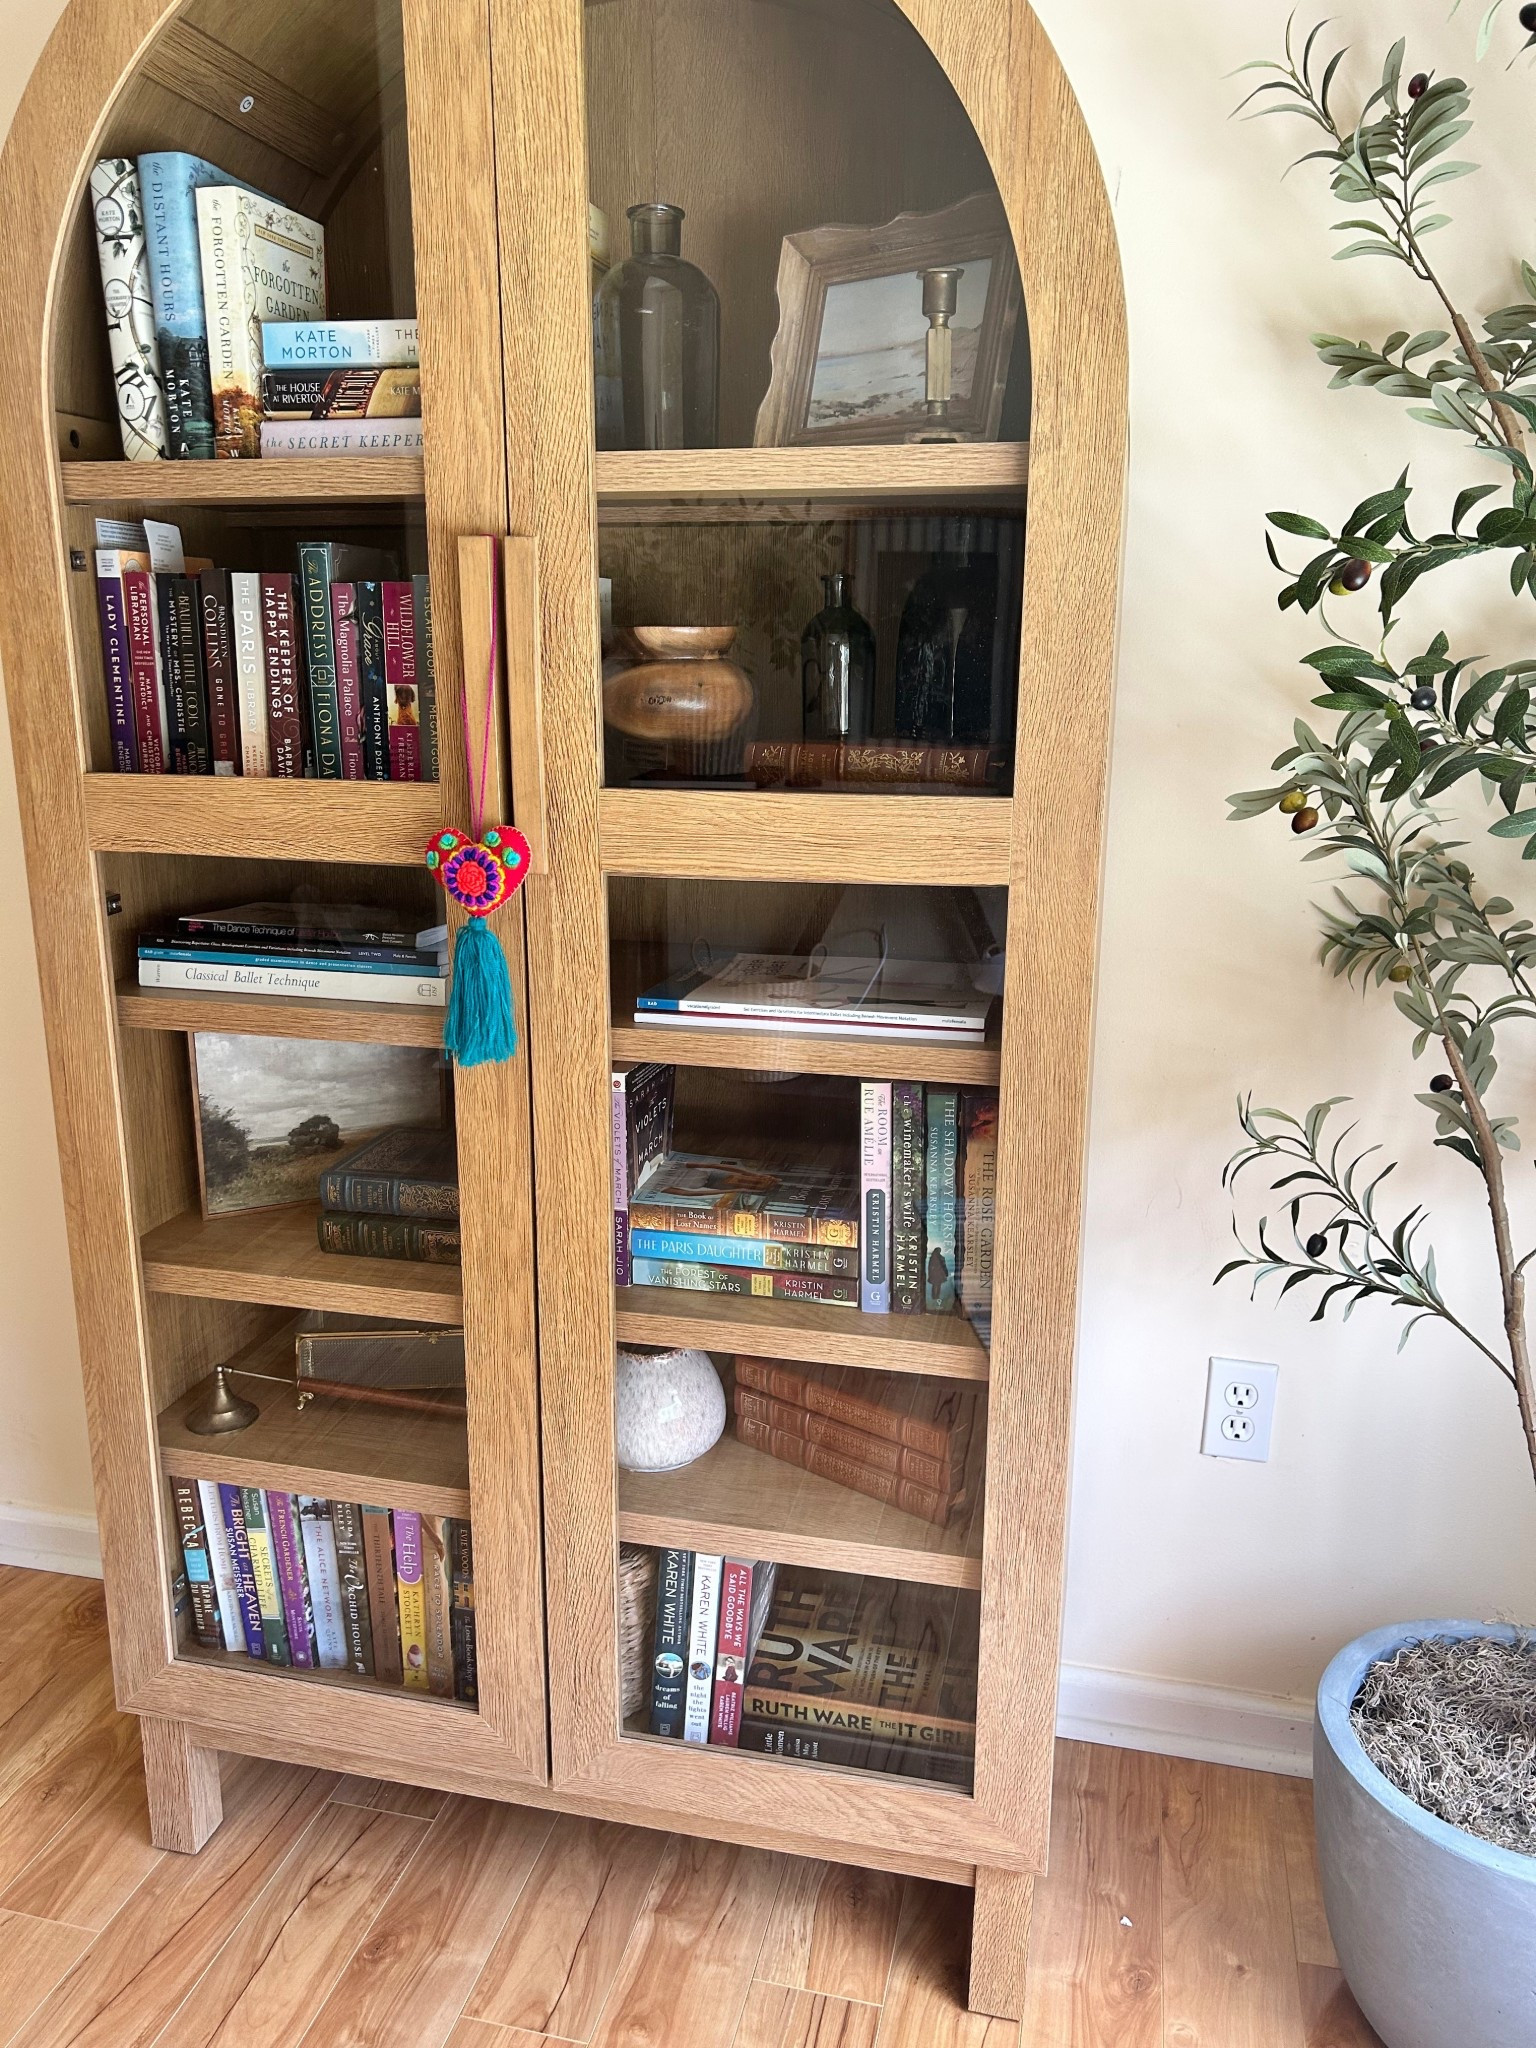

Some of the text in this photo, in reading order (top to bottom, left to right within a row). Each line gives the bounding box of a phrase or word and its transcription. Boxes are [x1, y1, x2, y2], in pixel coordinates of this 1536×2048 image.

[152, 182, 177, 322] DISTANT HOURS
[212, 217, 234, 380] FORGOTTEN GARDEN
[253, 266, 320, 306] FORGOTTEN
[266, 296, 310, 322] GARDEN
[282, 346, 352, 358] MORTON
[296, 330, 336, 342] KATE
[165, 369, 193, 434] KATE MORTON
[282, 394, 326, 404] RIVERTON
[290, 382, 320, 392] HOUSE
[390, 386, 410, 396] KATE
[266, 434, 424, 450] the SECRET KEEPER
[130, 586, 142, 641] LIBRARIAN
[139, 592, 151, 646] PERSONAL
[204, 594, 222, 669] COLLINS
[218, 606, 228, 658] BRANDILYN
[308, 577, 328, 658] ADDRESS
[240, 580, 257, 734] THE PARIS LIBRARY
[264, 587, 283, 718] HAPPY ENDINGS
[276, 592, 294, 713] THE KEEPER OF
[336, 592, 354, 717] The Magnolia Palace
[362, 611, 384, 666] Grace
[386, 622, 400, 650] HILL
[400, 594, 416, 678] WILDFLOWER
[424, 596, 436, 678] ESCAPE ROOM
[106, 595, 126, 726] LADY CLEMENTINE
[168, 600, 186, 733] MYSTERY MRS. CHRISTIE
[178, 595, 199, 727] BEAUTIFUL LITTLE FOOLS
[138, 671, 148, 710] BENEDICT
[216, 678, 226, 726] GONE TO
[316, 693, 334, 746] FIONA
[372, 696, 383, 746] ANTHONY
[212, 922, 226, 932] The
[226, 924, 250, 934] Dance
[251, 925, 287, 937] Technique
[288, 928, 296, 936] of
[184, 967, 320, 992] Classical Ballet Technique
[629, 1082, 656, 1108] SARAH
[635, 1098, 667, 1134] VIOLETS
[864, 1088, 874, 1114] RUE
[614, 1112, 622, 1156] VIOLETS
[638, 1132, 664, 1165] MARCH
[878, 1109, 888, 1148] ROOM
[903, 1118, 916, 1228] winemaker's wife
[929, 1126, 939, 1226] SUSANNA KEARSLEY
[942, 1098, 956, 1254] THE SHADOWY HORSES
[688, 1212, 707, 1220] Book
[692, 1220, 717, 1230] Names
[772, 1220, 806, 1230] KRISTIN
[773, 1228, 806, 1238] HARMEL
[872, 1193, 880, 1281] KRISTIN HARMEL
[966, 1174, 976, 1268] SUSANNA KEARSLEY
[980, 1150, 994, 1290] THE ROSE GARDEN
[616, 1256, 624, 1276] JIO
[637, 1238, 658, 1250] THE
[661, 1240, 694, 1255] PARIS
[697, 1244, 761, 1262] DAUGHTER
[784, 1258, 830, 1272] HARMEL
[786, 1248, 830, 1260] KRISTIN
[896, 1234, 906, 1288] HARMEL
[908, 1234, 918, 1290] KRISTIN
[648, 1275, 706, 1289] VANISHING
[709, 1281, 741, 1292] STARS
[675, 1268, 716, 1280] FOREST
[784, 1288, 823, 1300] HARMEL
[785, 1280, 824, 1290] KRISTIN
[178, 1488, 199, 1548] REBECCA
[242, 1488, 252, 1520] Meissner
[251, 1492, 260, 1516] Susan
[336, 1504, 346, 1531] RILEY
[278, 1509, 294, 1581] FRENCH GARDENER
[405, 1525, 414, 1542] The
[226, 1528, 245, 1598] SUSAN MEISSNER
[230, 1509, 262, 1632] BRIGHT HEAVEN
[248, 1538, 267, 1608] CHARMED LIFE
[260, 1546, 274, 1588] SECRETS
[314, 1526, 332, 1624] THE ALICE NETWORK
[400, 1542, 418, 1574] Help
[462, 1548, 470, 1579] WOODS
[190, 1584, 199, 1594] DU
[200, 1584, 213, 1614] DAPHNE
[434, 1593, 441, 1606] TO
[662, 1550, 680, 1645] KAREN WHITE
[699, 1574, 712, 1616] KAREN
[724, 1573, 738, 1640] SAID GOODBYE
[734, 1570, 748, 1648] ALL THE WAYS WE
[403, 1590, 412, 1636] STOCKETT
[412, 1591, 422, 1638] KATHRYN
[435, 1609, 444, 1658] SPLENDOR
[352, 1624, 363, 1658] HOUSE
[464, 1625, 474, 1680] Lost Bookshop
[696, 1620, 708, 1656] WHITE
[751, 1586, 822, 1690] RUTH
[654, 1684, 680, 1692] dreams
[878, 1652, 919, 1707] THE
[655, 1701, 678, 1710] falling
[752, 1698, 964, 1745] RUTH WARE THE IT GIRL
[764, 1732, 773, 1753] Little
